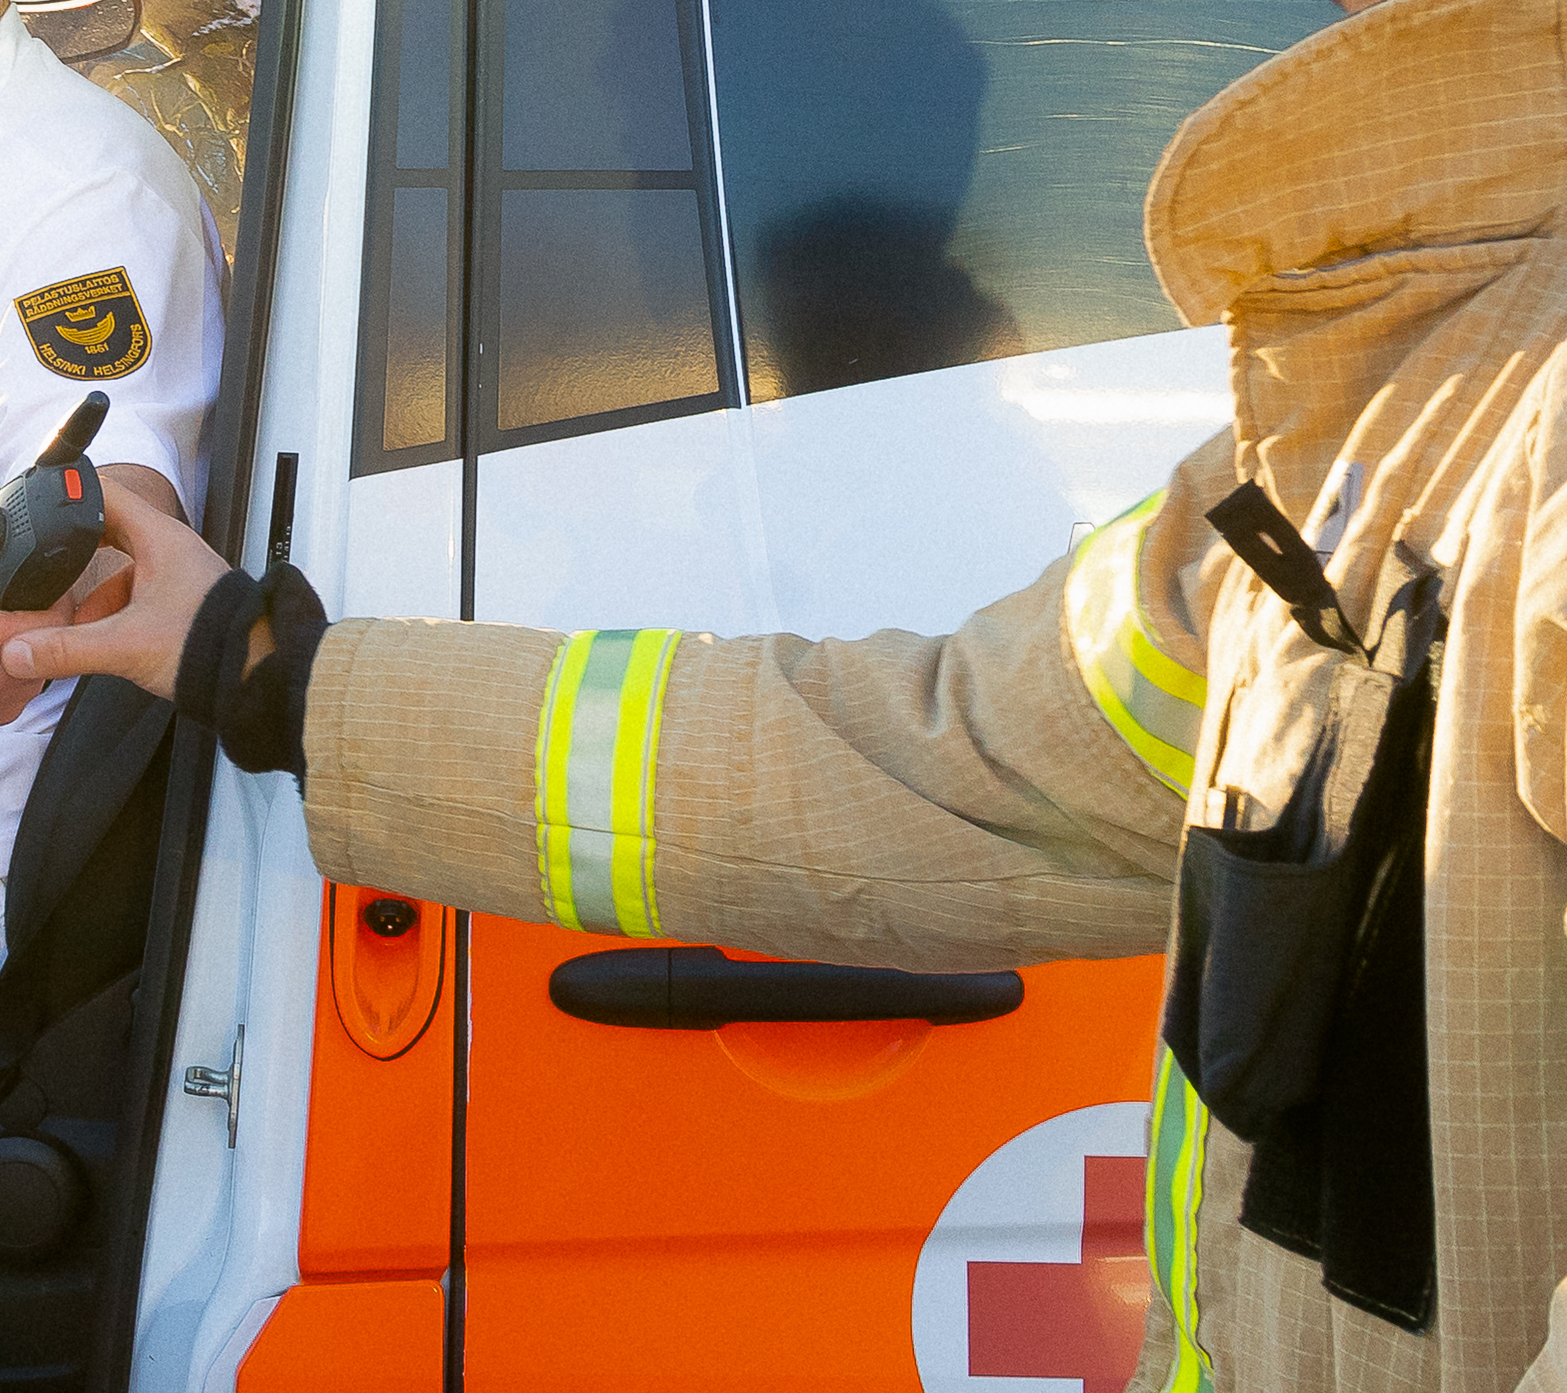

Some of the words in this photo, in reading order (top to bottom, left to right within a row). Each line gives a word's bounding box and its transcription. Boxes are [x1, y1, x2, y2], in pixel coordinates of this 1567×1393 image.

[23, 274, 119, 308] PELASTUSLAITOS
[39, 343, 86, 376] HELSINKI
[93, 323, 144, 376] HELSINGFORS
